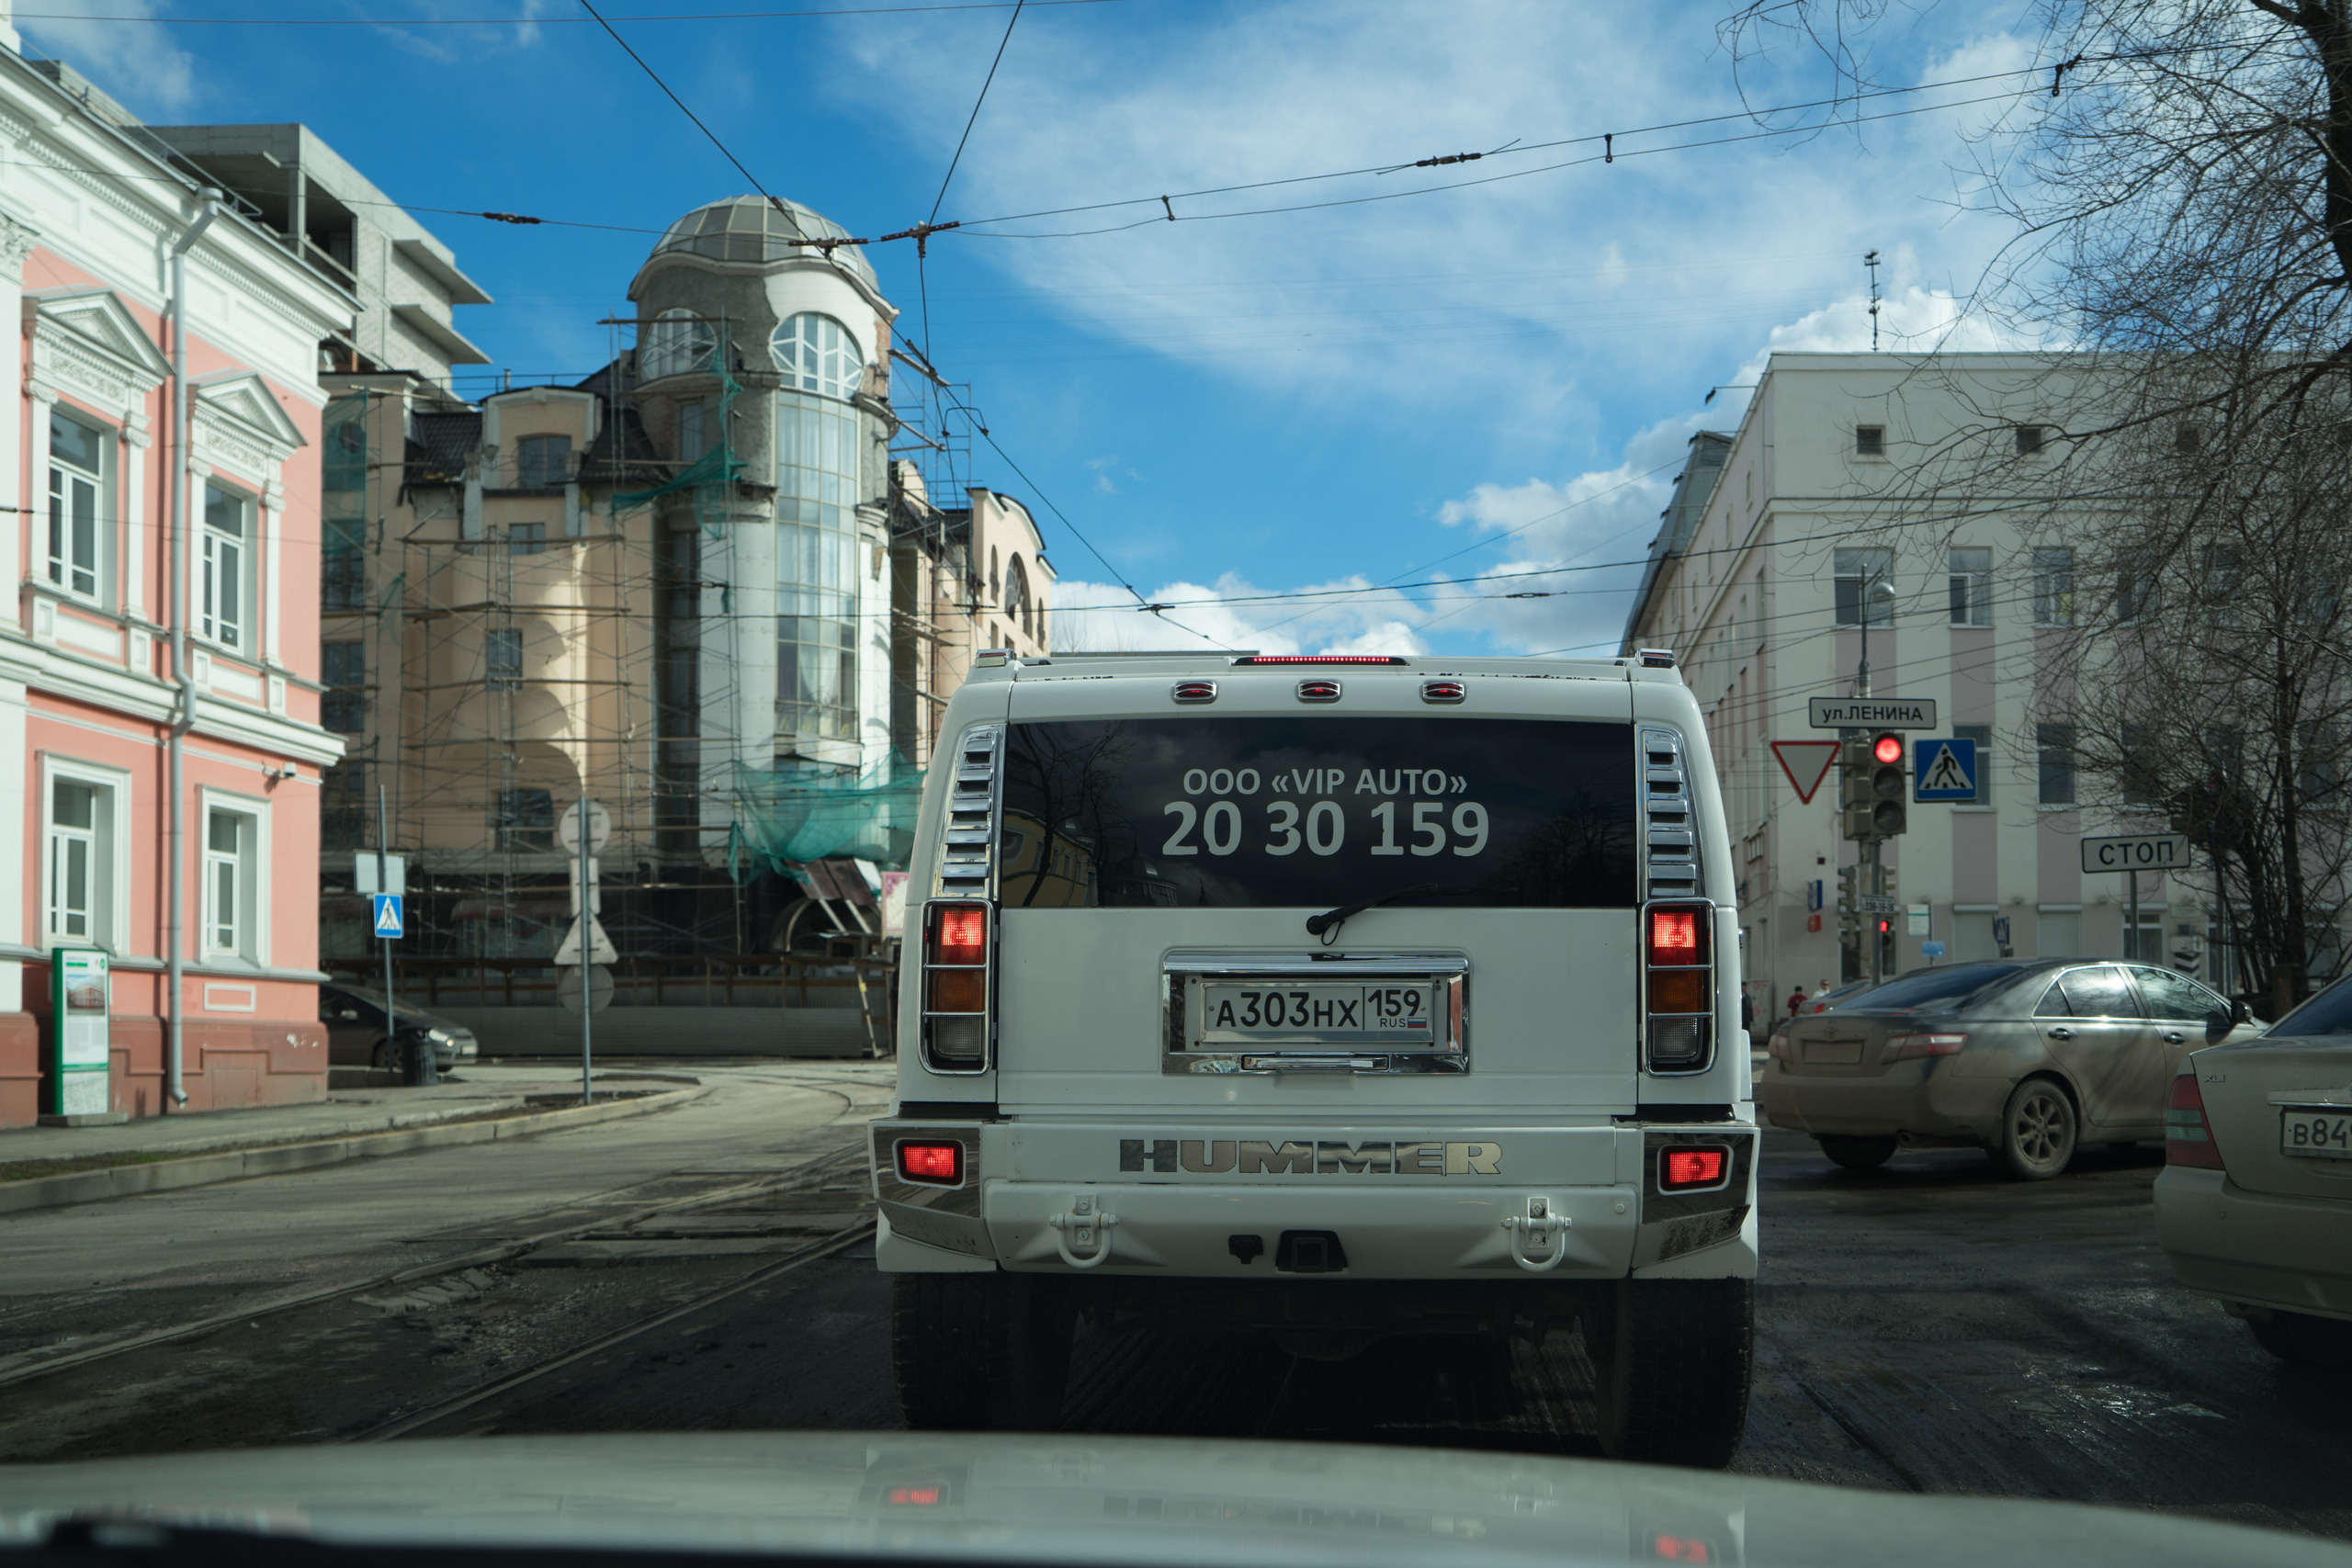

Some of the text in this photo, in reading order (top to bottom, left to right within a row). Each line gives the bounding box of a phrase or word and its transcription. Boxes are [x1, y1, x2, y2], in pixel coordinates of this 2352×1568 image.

[1822, 705, 1924, 724] ул.ЛЕНИНА
[1182, 768, 1468, 795] ООО «VIP AUTO»
[1162, 800, 1489, 857] 20 30 159
[2098, 841, 2174, 865] СТОП
[1216, 989, 1421, 1028] А303НХ 159
[1379, 1018, 1407, 1028] RUS
[2293, 1118, 2352, 1148] В84
[1119, 1139, 1503, 1176] HUMMER
